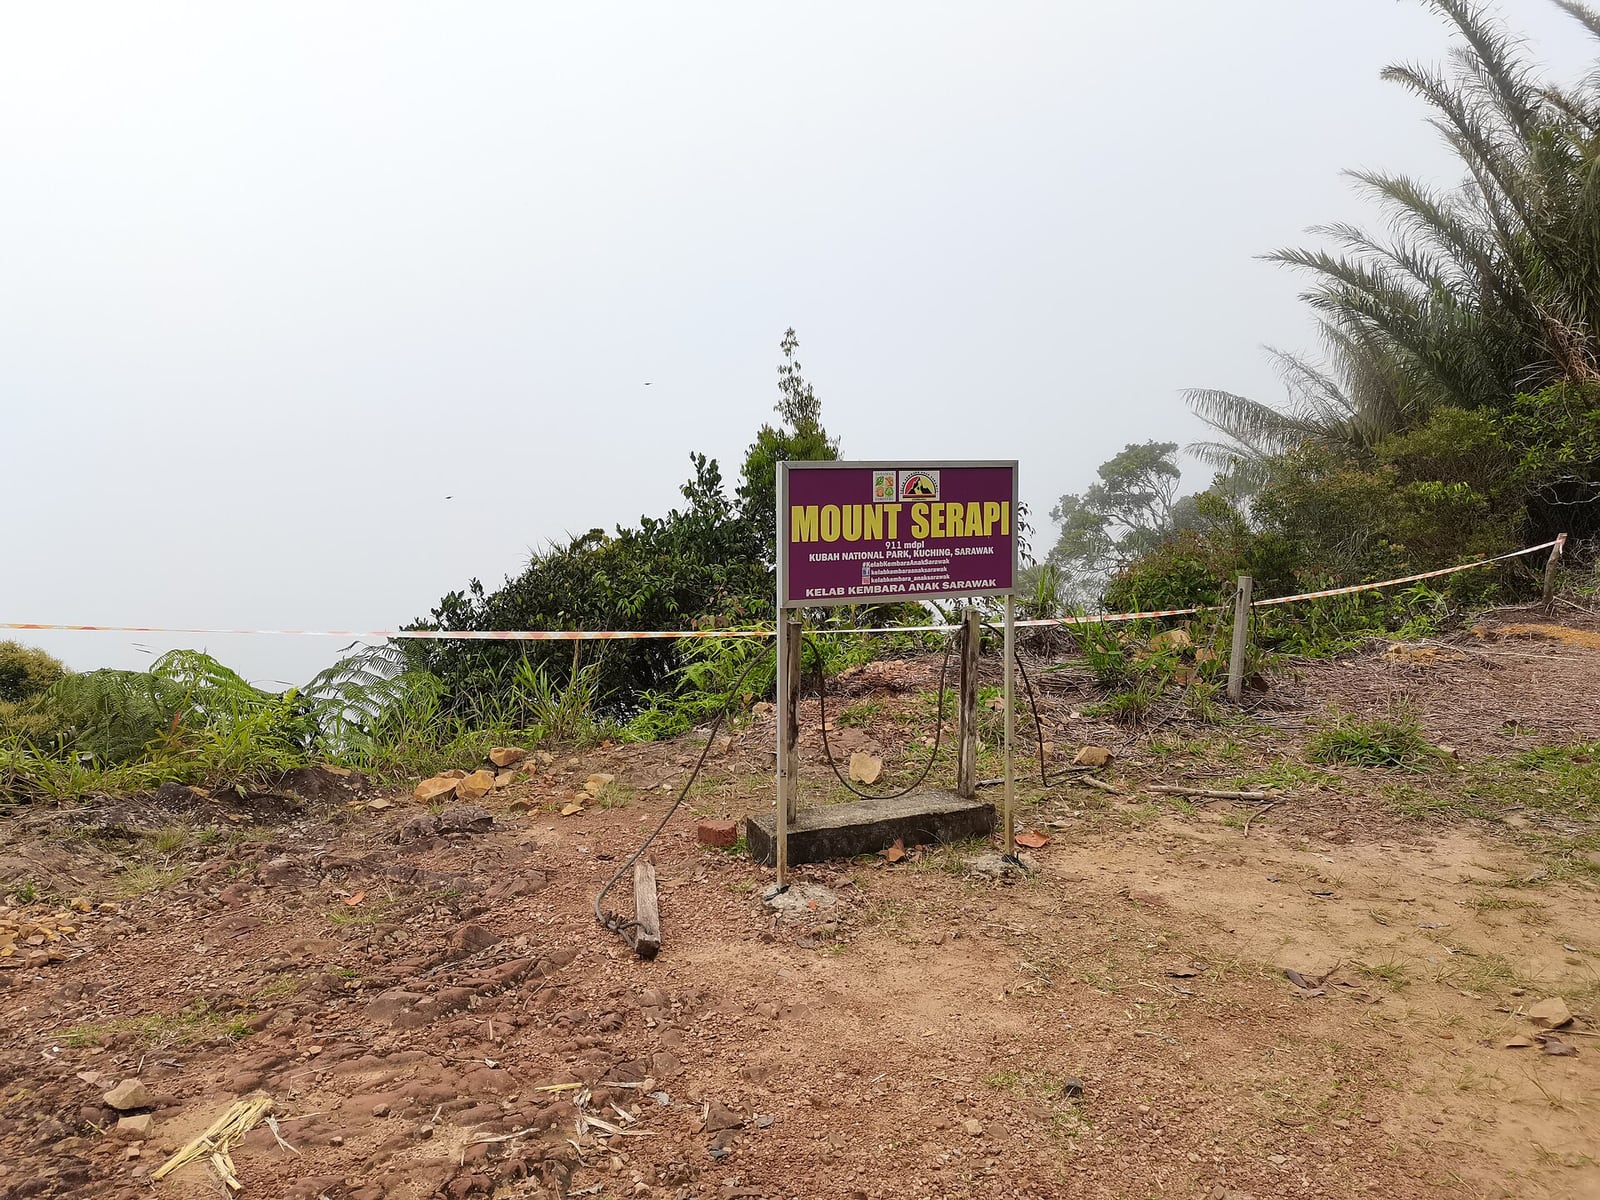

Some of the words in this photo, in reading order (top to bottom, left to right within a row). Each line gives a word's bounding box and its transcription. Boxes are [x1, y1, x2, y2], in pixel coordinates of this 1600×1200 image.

[791, 504, 902, 543] MOUNT
[911, 501, 1010, 539] SERAPI
[809, 552, 840, 562] KUBAH
[842, 551, 884, 561] NATIONAL
[886, 550, 911, 559] PARK,
[913, 549, 953, 558] KUCHING,
[954, 546, 994, 556] SARAWAK
[885, 541, 902, 550] 911
[904, 541, 925, 551] mdpl
[862, 558, 950, 568] #KelabKembaraAnakSarawak
[805, 587, 845, 597] KELAB
[848, 584, 906, 595] KEMBARA
[908, 582, 940, 592] ANAK
[941, 579, 997, 590] SARAWAK
